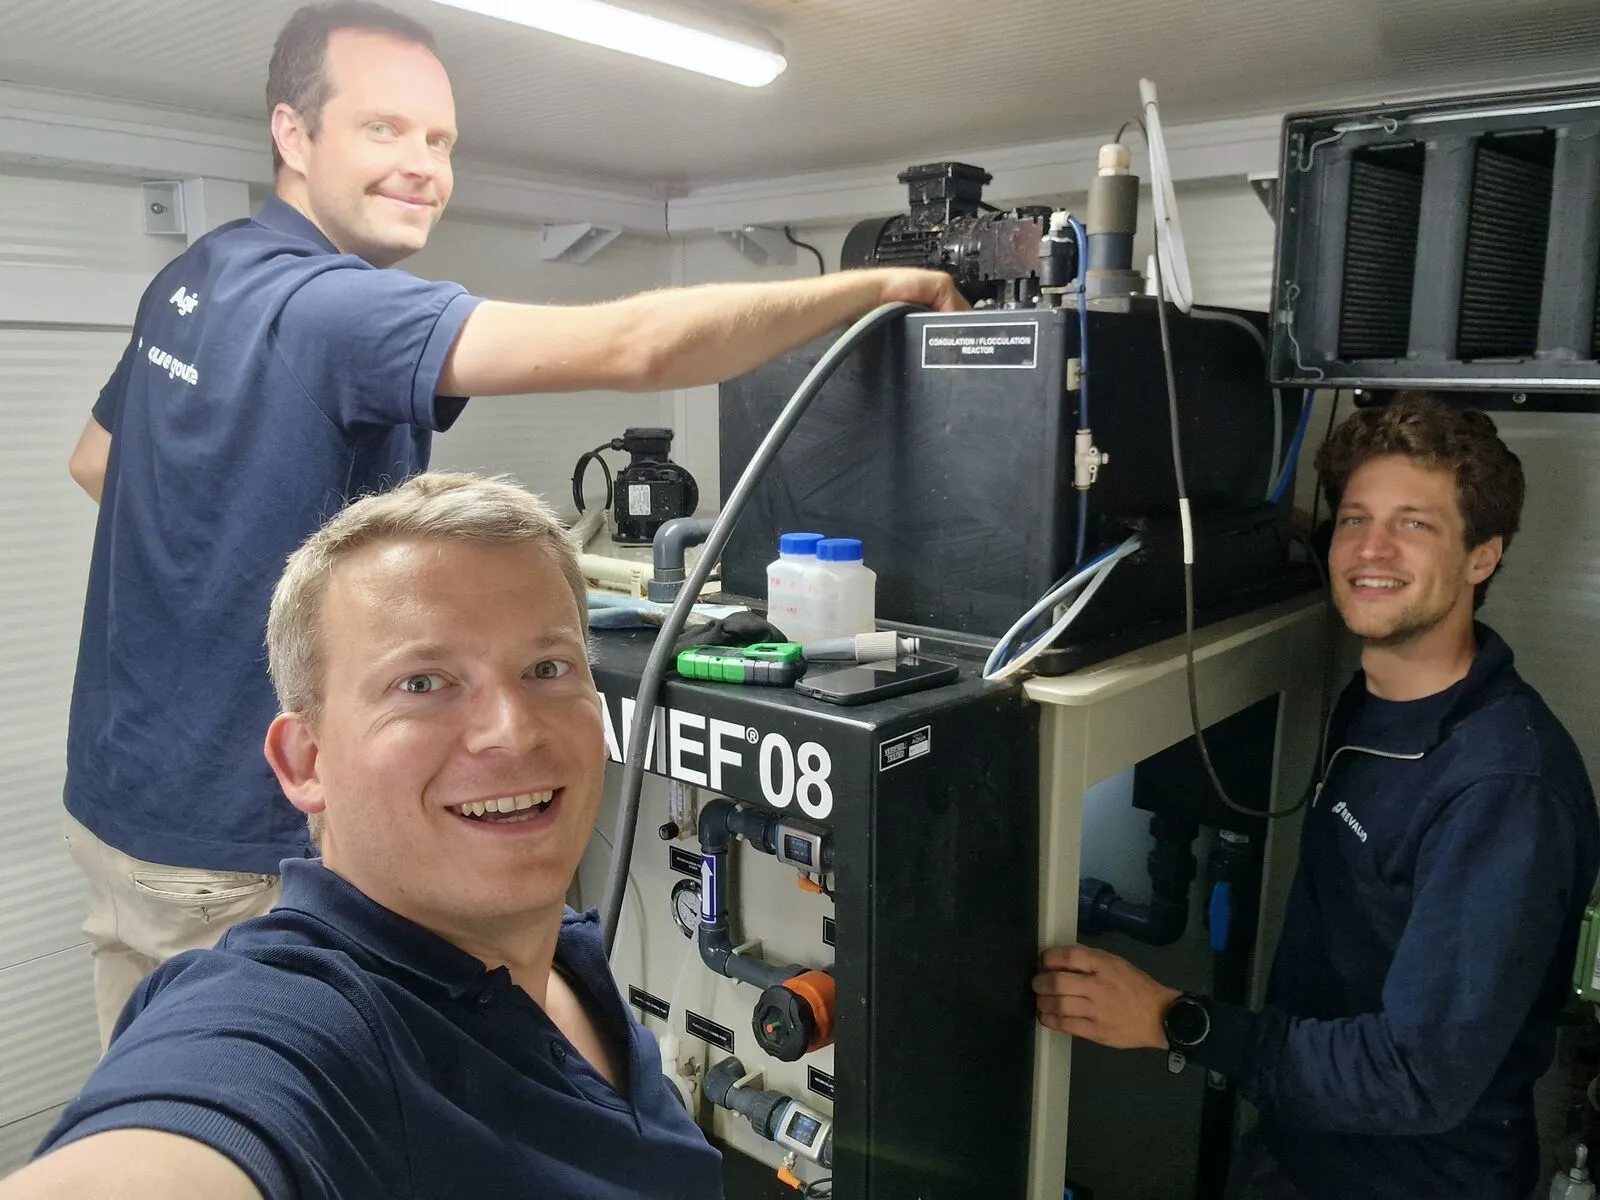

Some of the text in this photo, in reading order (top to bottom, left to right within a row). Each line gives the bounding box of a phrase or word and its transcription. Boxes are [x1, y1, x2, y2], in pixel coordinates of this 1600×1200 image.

[169, 286, 199, 316] Agir
[928, 337, 976, 346] COAGULATION
[979, 336, 1032, 345] FLOCCULATION
[961, 346, 995, 354] REACTOR
[759, 732, 834, 820] 08
